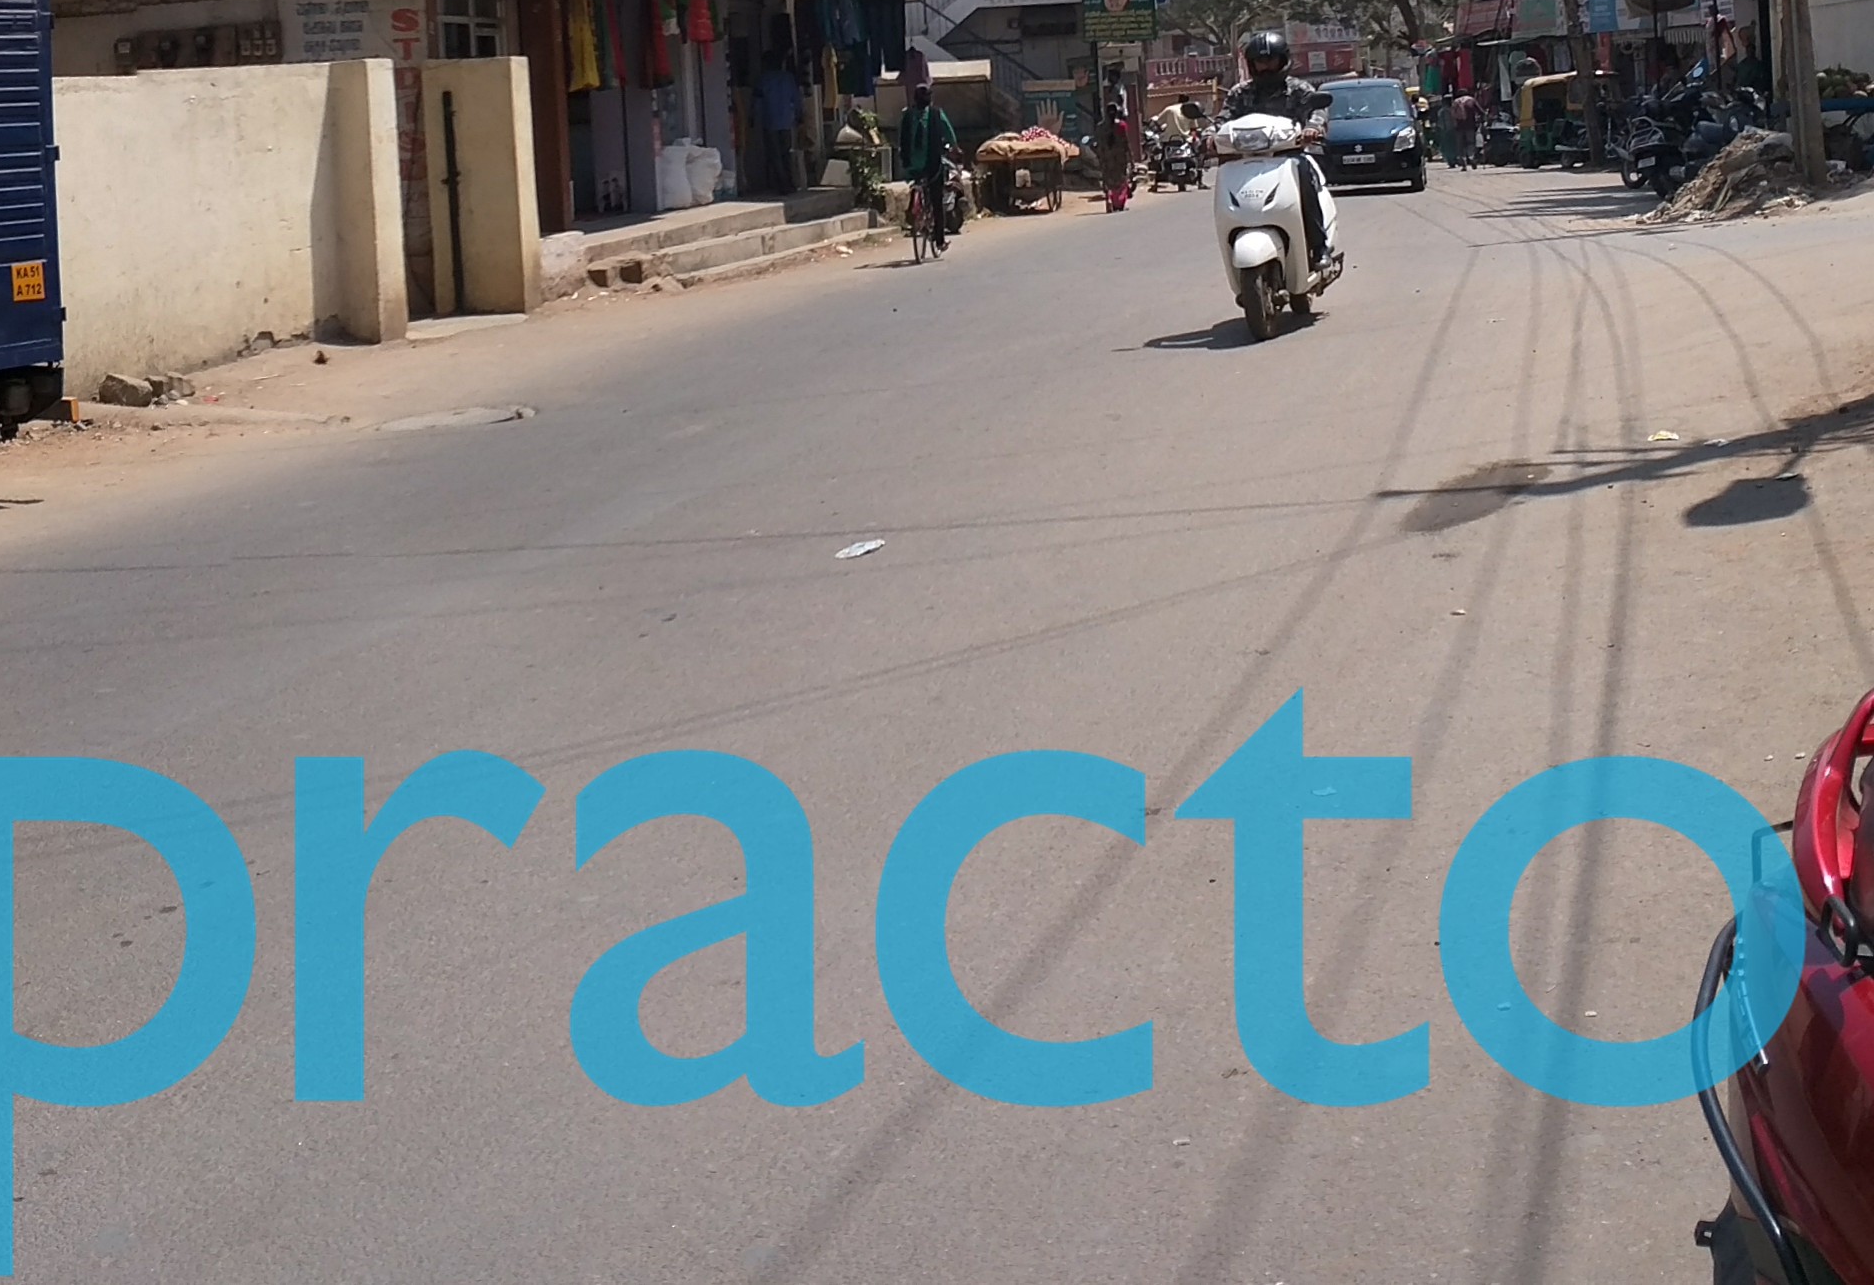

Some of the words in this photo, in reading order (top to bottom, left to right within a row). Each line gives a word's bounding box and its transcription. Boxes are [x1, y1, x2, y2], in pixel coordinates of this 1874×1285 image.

[16, 267, 29, 279] KA
[30, 265, 40, 277] 51
[16, 284, 24, 296] A
[25, 283, 42, 296] 712
